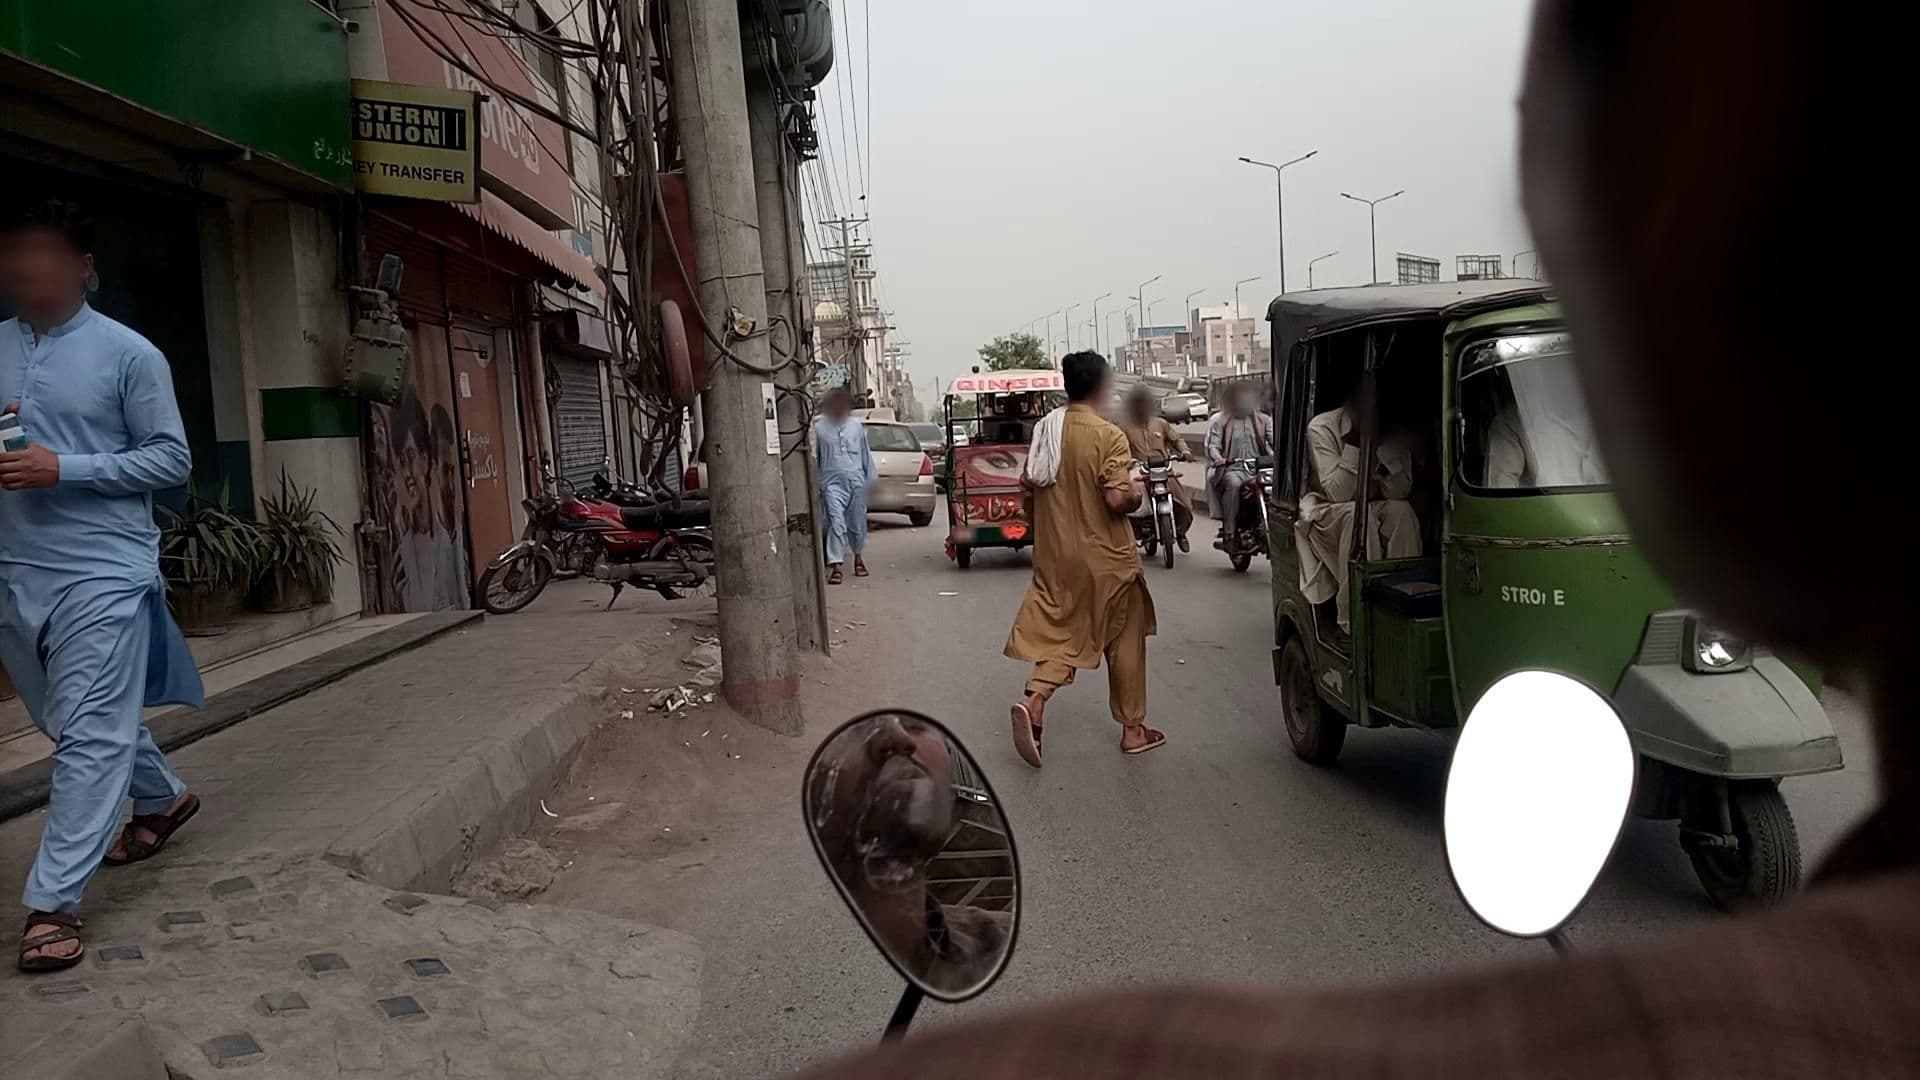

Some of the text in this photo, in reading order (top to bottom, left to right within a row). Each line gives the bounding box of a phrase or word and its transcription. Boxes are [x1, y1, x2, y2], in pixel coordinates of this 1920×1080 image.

[351, 102, 440, 126] STERN
[359, 121, 440, 144] UNION
[353, 160, 464, 184] EY TRANSFER
[957, 377, 1060, 391] QINGQI
[1501, 585, 1565, 606] STROE
